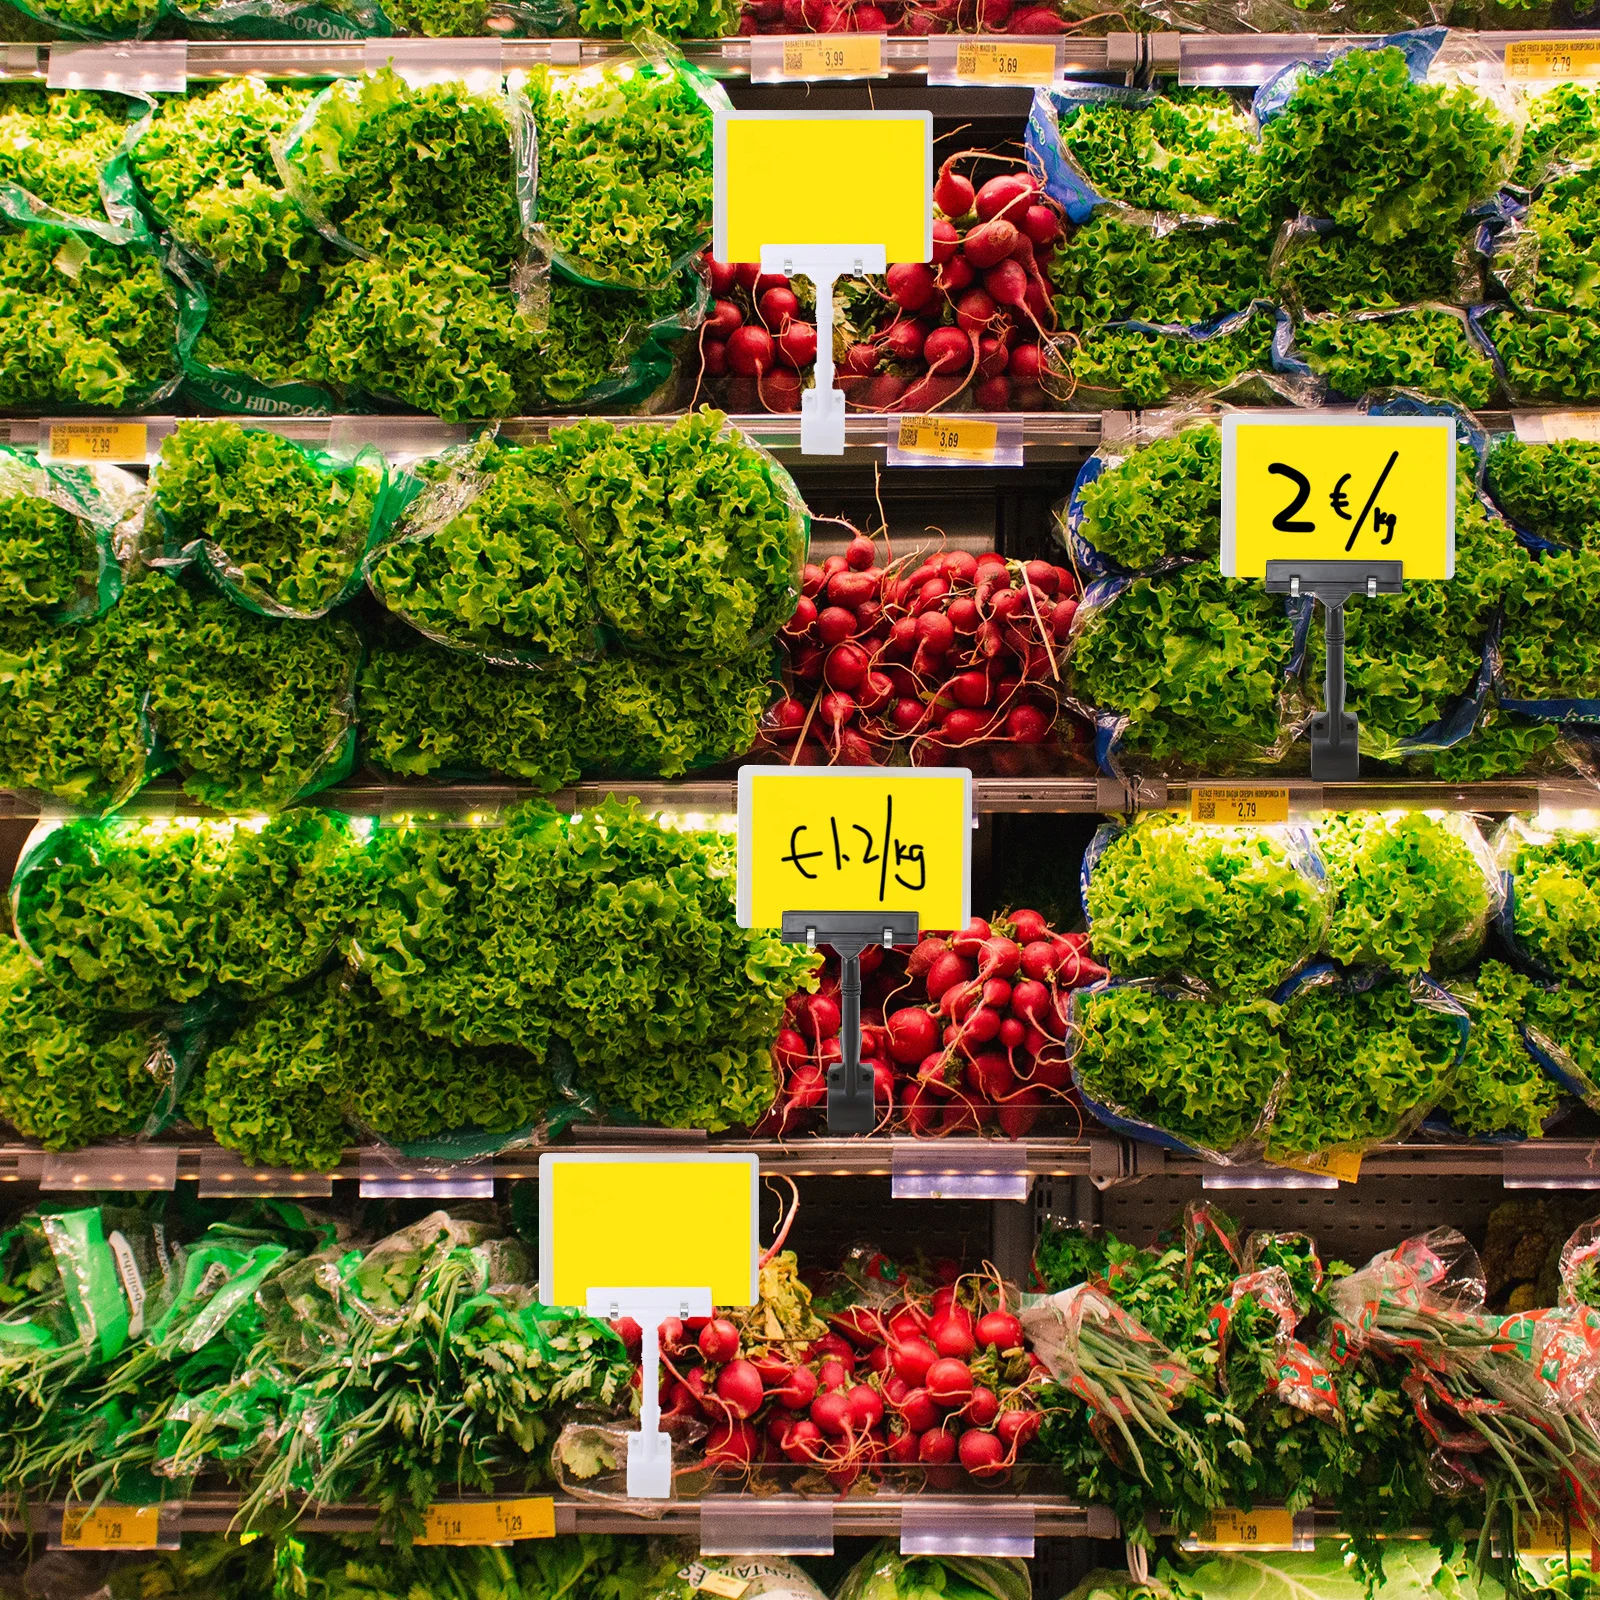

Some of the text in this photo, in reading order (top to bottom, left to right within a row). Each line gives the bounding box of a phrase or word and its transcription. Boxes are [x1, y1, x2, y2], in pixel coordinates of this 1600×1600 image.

[1512, 44, 1527, 53] ALFACE
[1554, 43, 1569, 52] CRESPA
[825, 51, 844, 69] 3,99
[999, 57, 1018, 74] 3,69
[1552, 56, 1571, 72] 2,79
[91, 438, 110, 453] 2,99
[940, 431, 959, 449] 3,69
[1267, 462, 1316, 533] 2
[1198, 789, 1213, 797] ALFACE
[1240, 789, 1254, 798] CRESPA
[1238, 802, 1257, 819] 2,79
[104, 1522, 122, 1540] 1,29
[444, 1520, 462, 1537] 1,14
[504, 1515, 522, 1533] 1,29
[1239, 1524, 1258, 1541] 1,29
